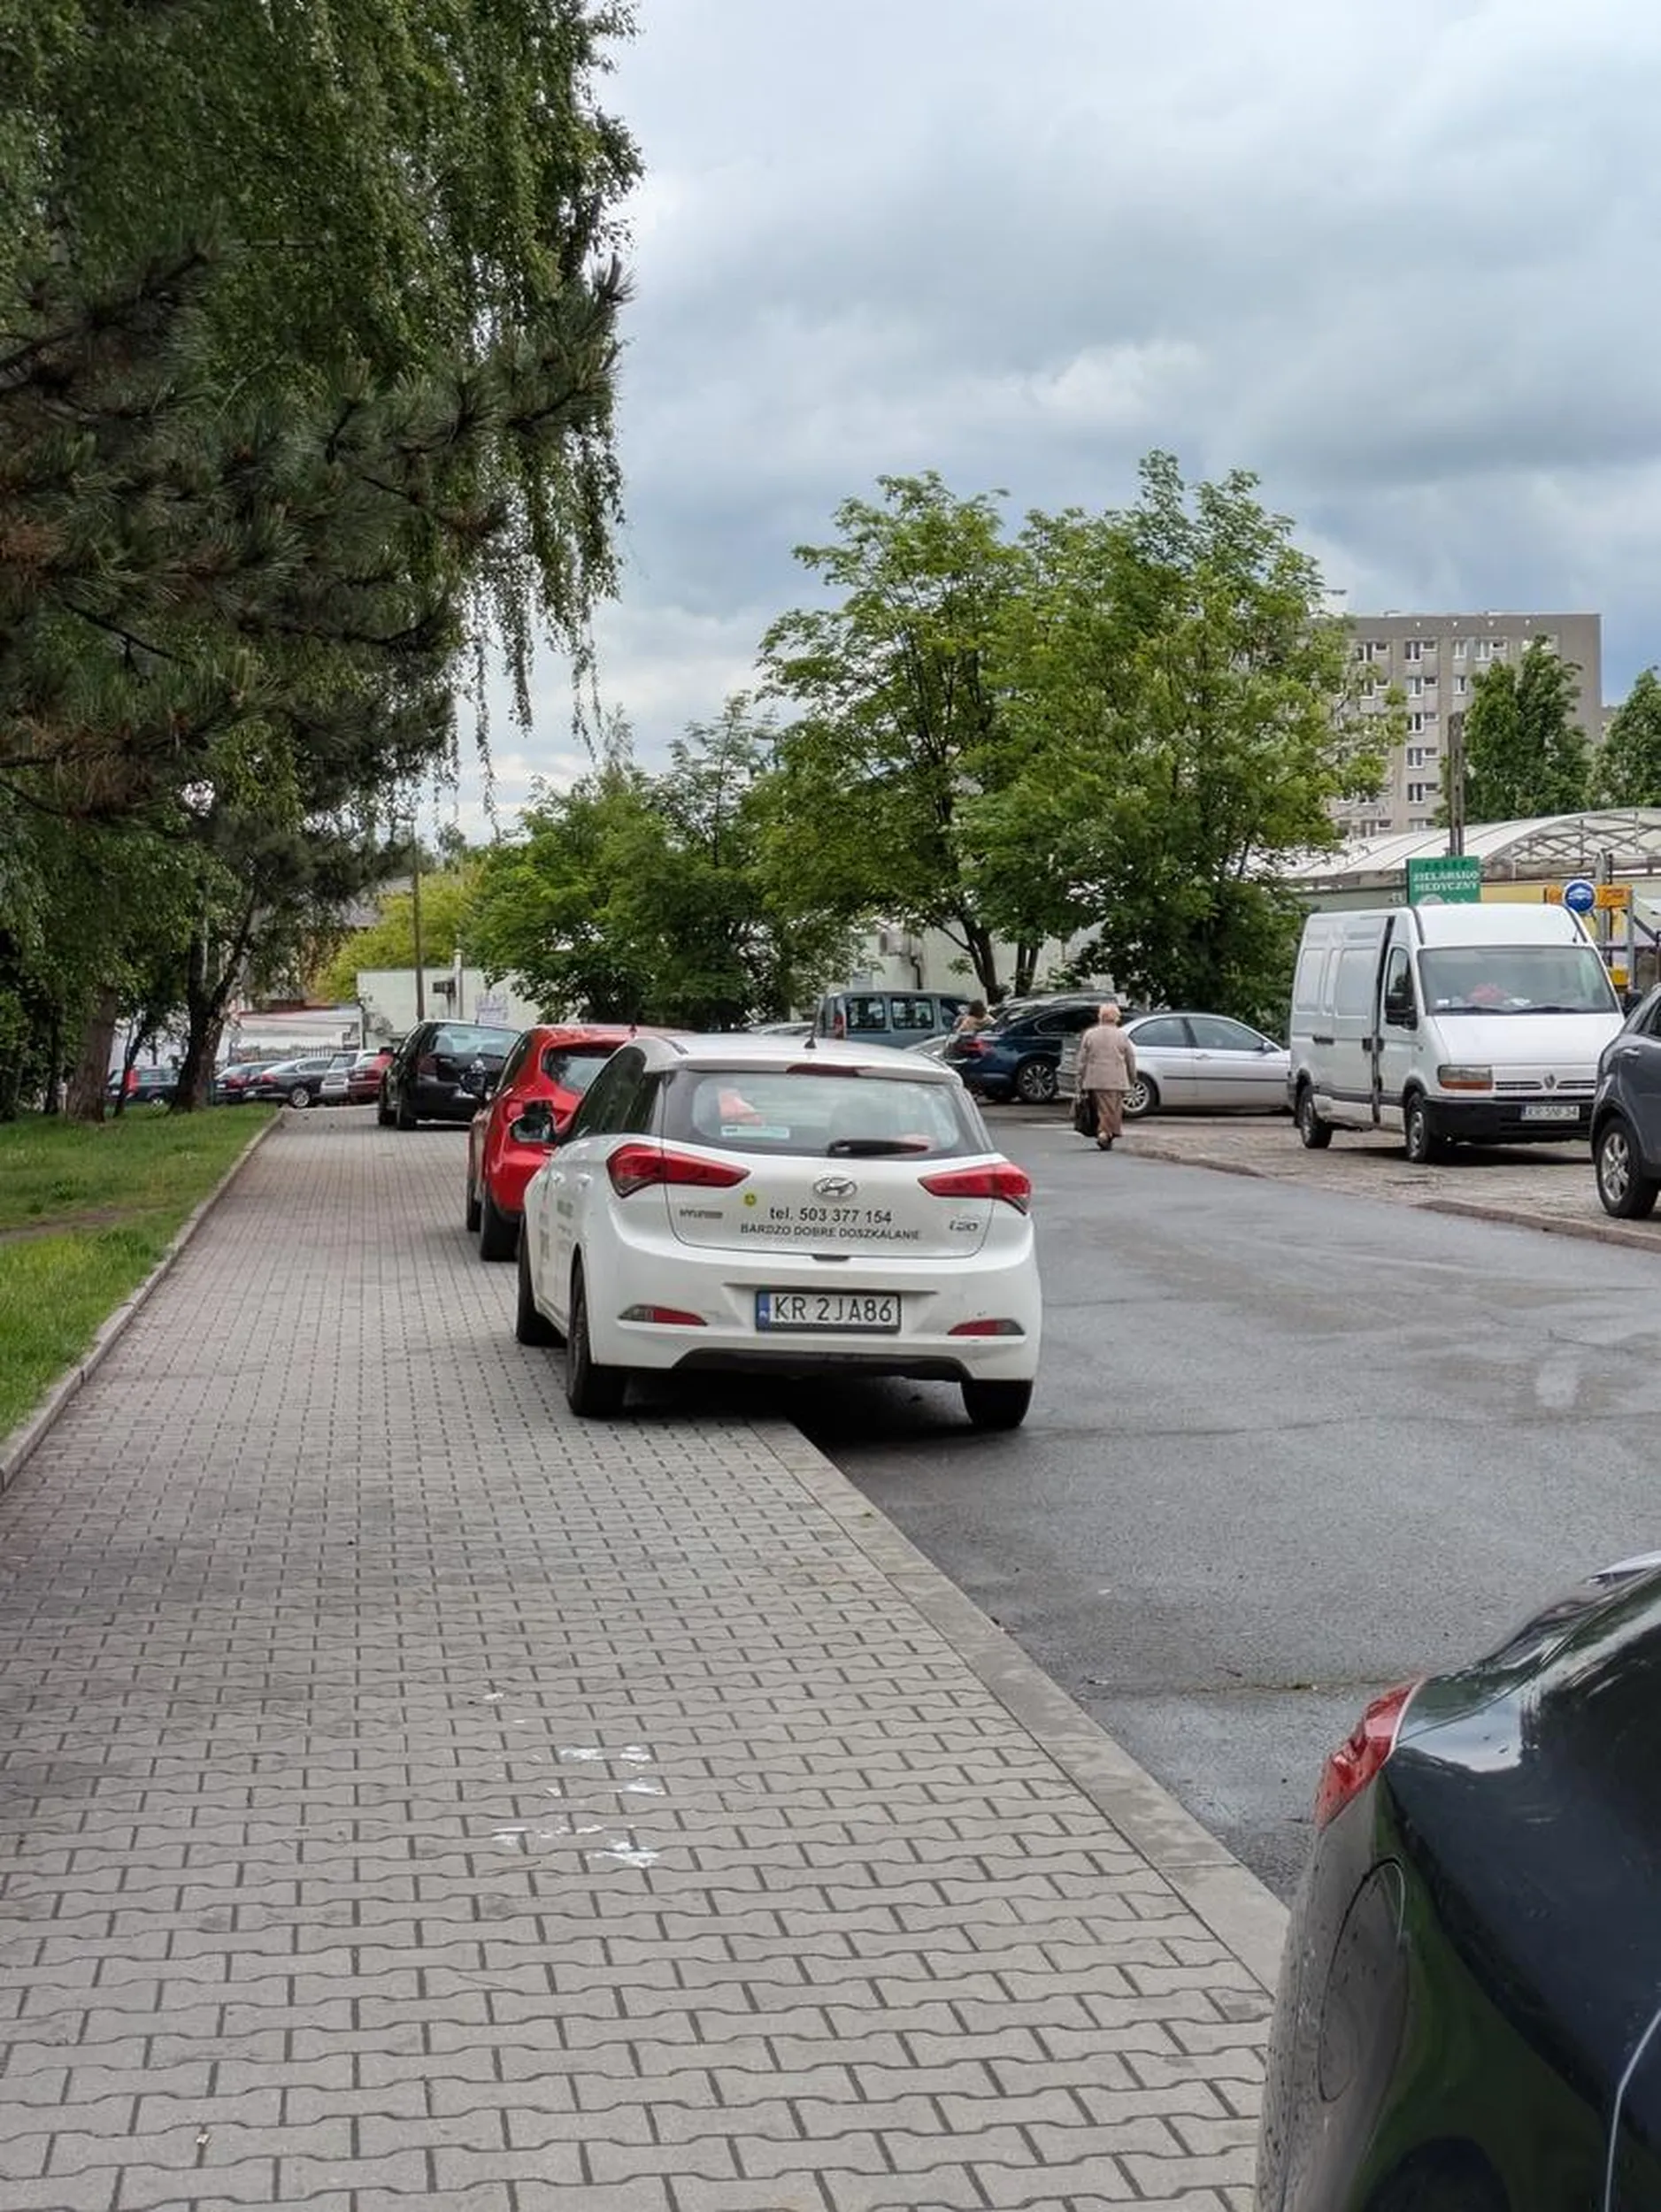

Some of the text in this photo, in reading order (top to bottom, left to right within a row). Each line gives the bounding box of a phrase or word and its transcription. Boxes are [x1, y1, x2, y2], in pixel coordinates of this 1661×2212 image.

[769, 1207, 892, 1225] tel. 503 377 154
[741, 1224, 791, 1236] BARDZO
[794, 1225, 836, 1238] DOBRE
[775, 1296, 892, 1323] KR 2JA86
